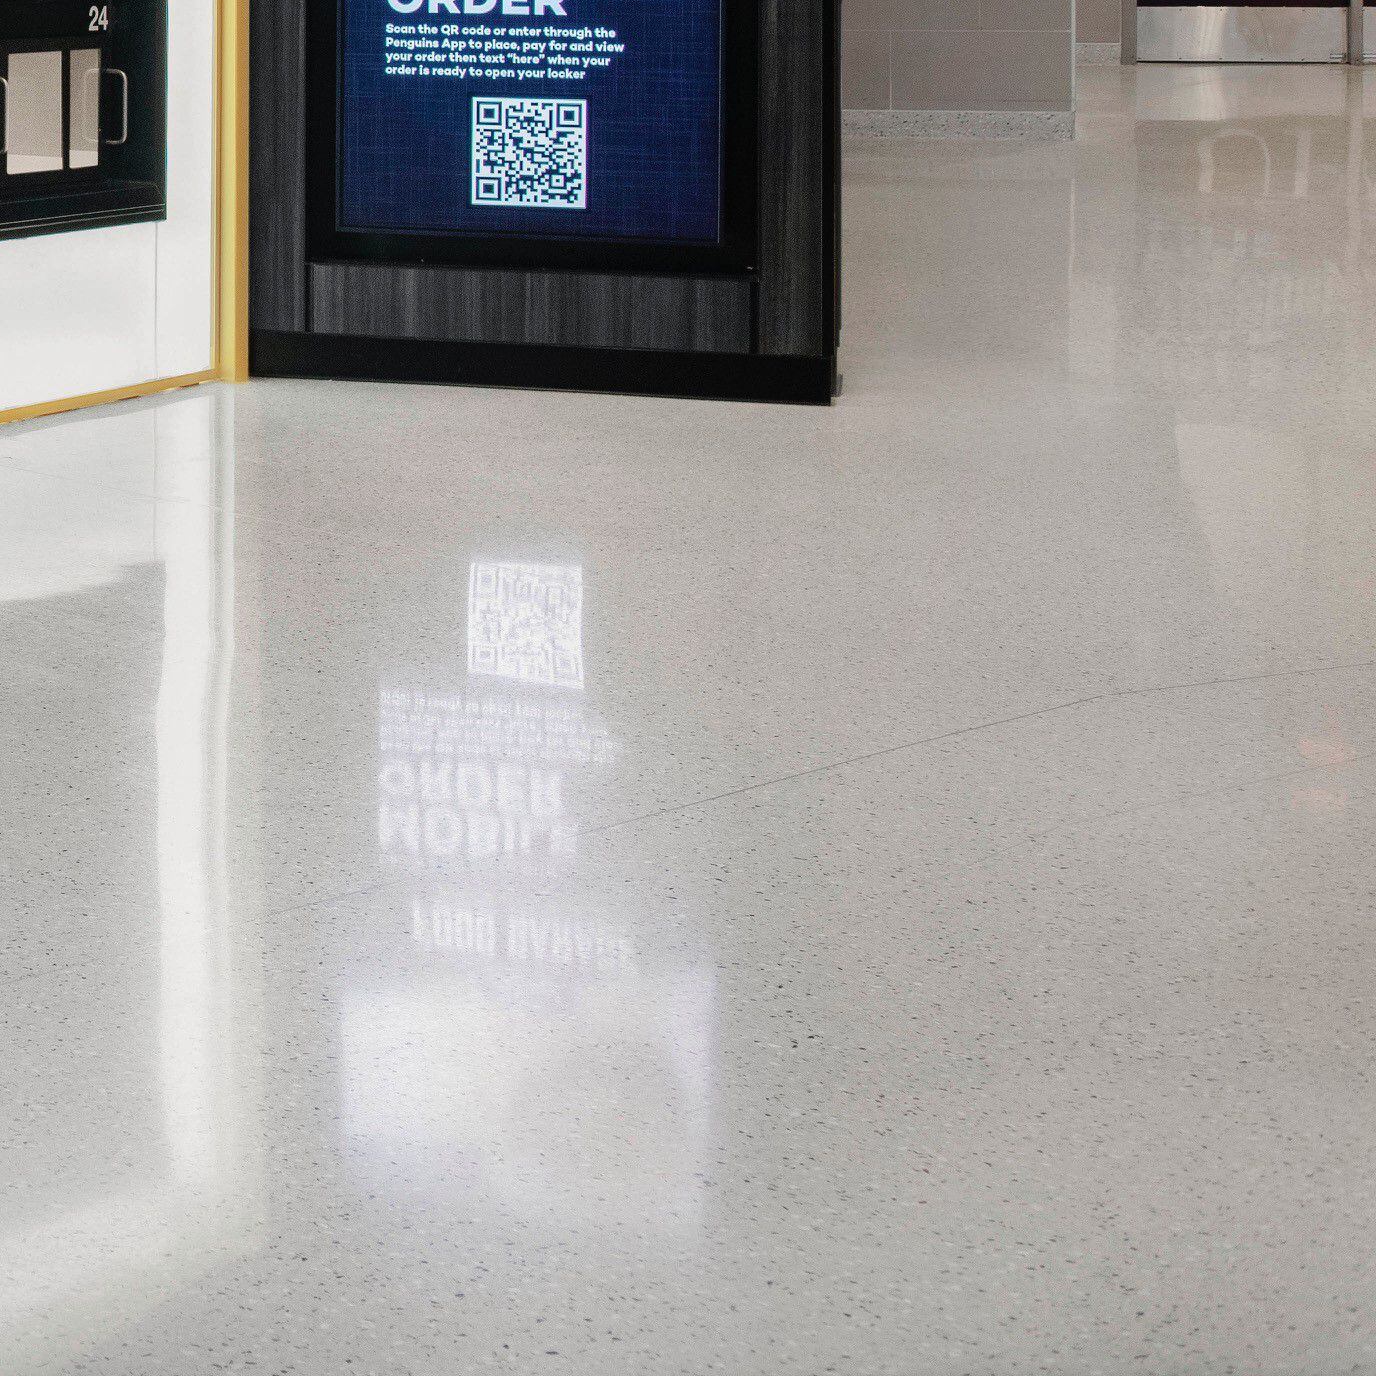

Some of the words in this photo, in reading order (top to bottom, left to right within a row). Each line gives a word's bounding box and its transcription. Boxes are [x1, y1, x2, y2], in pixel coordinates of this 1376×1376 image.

[89, 5, 108, 32] 24
[386, 24, 415, 34] Scan
[418, 25, 438, 34] the
[441, 26, 458, 35] QR
[462, 26, 490, 36] code
[494, 28, 506, 36] or
[509, 27, 541, 37] enter
[544, 27, 591, 39] through
[594, 28, 615, 38] the
[386, 37, 439, 50] Penguins
[442, 39, 466, 51] App
[468, 40, 482, 49] to
[484, 39, 520, 51] place,
[523, 43, 546, 52] pay
[549, 41, 567, 51] for
[570, 41, 593, 51] and
[595, 42, 624, 52] view
[386, 53, 413, 62] your
[415, 52, 446, 62] order
[449, 53, 477, 63] then
[479, 54, 505, 63] text
[548, 55, 580, 65] when
[582, 58, 610, 67] your
[385, 65, 417, 75] order
[419, 65, 430, 75] is
[432, 67, 466, 78] ready
[469, 68, 483, 76] to
[485, 69, 515, 79] open
[517, 70, 545, 79] your
[548, 68, 585, 79] locker
